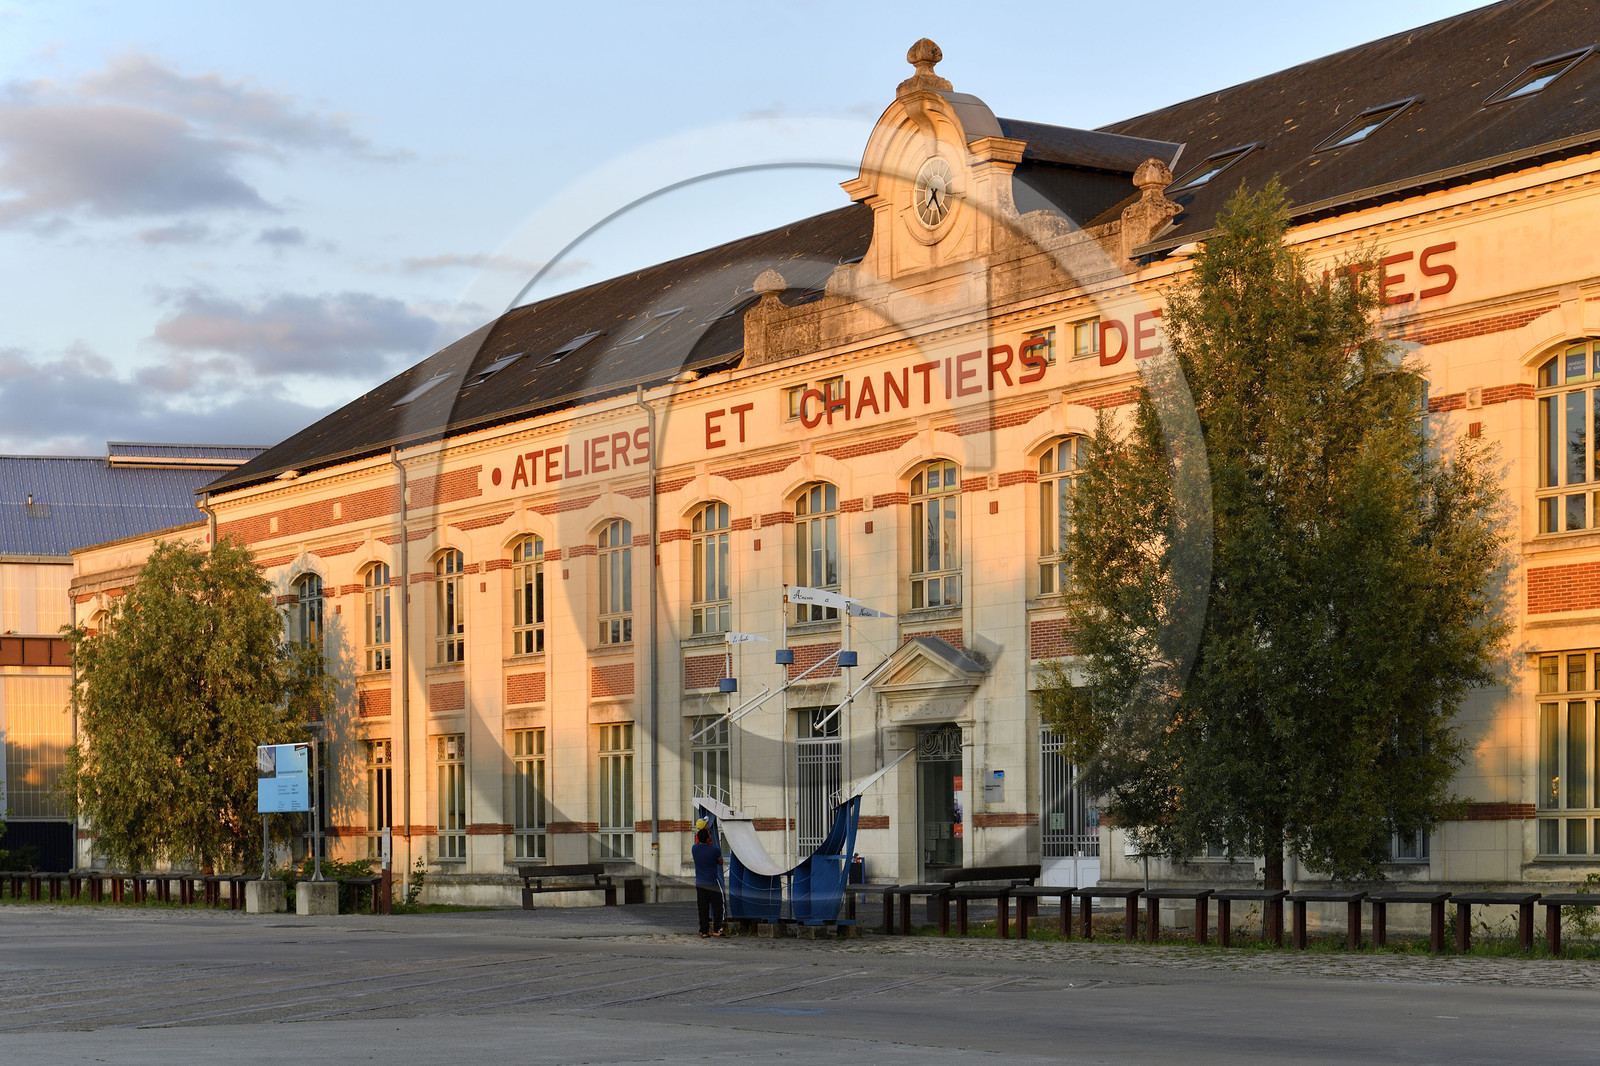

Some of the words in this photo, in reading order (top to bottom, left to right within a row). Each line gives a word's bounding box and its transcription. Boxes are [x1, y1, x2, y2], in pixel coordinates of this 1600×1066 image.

[511, 426, 651, 490] ATELIERS
[705, 402, 754, 450] ET
[799, 335, 1049, 430] CHANTIERS
[1099, 308, 1163, 367] DE
[904, 702, 952, 717] BUREAUX
